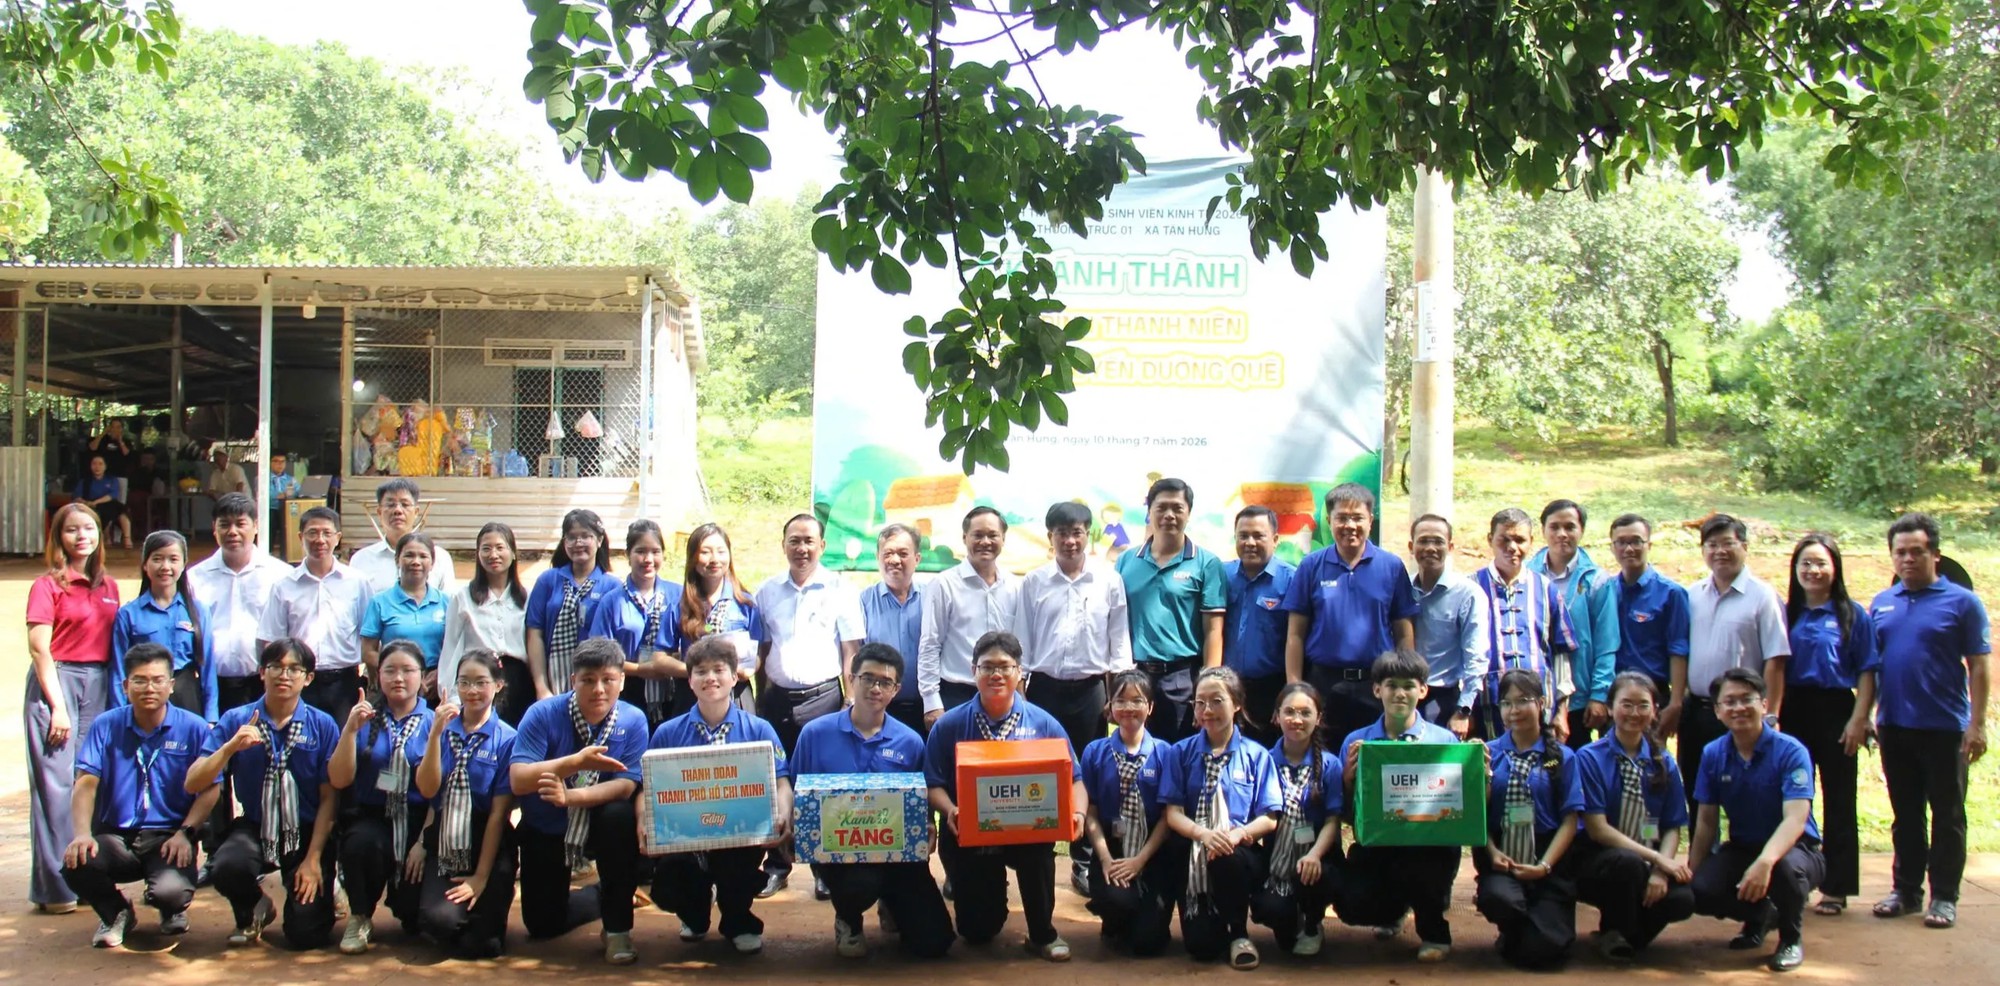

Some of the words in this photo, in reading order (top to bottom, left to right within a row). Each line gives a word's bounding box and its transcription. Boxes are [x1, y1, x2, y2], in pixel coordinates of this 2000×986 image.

[1108, 208, 1135, 219] SINH
[1167, 208, 1195, 219] KINH
[1180, 436, 1208, 446] 2026
[1391, 774, 1418, 786] UEH
[740, 783, 765, 798] MINH
[989, 784, 1020, 798] UEH
[834, 826, 895, 849] TẶNG
